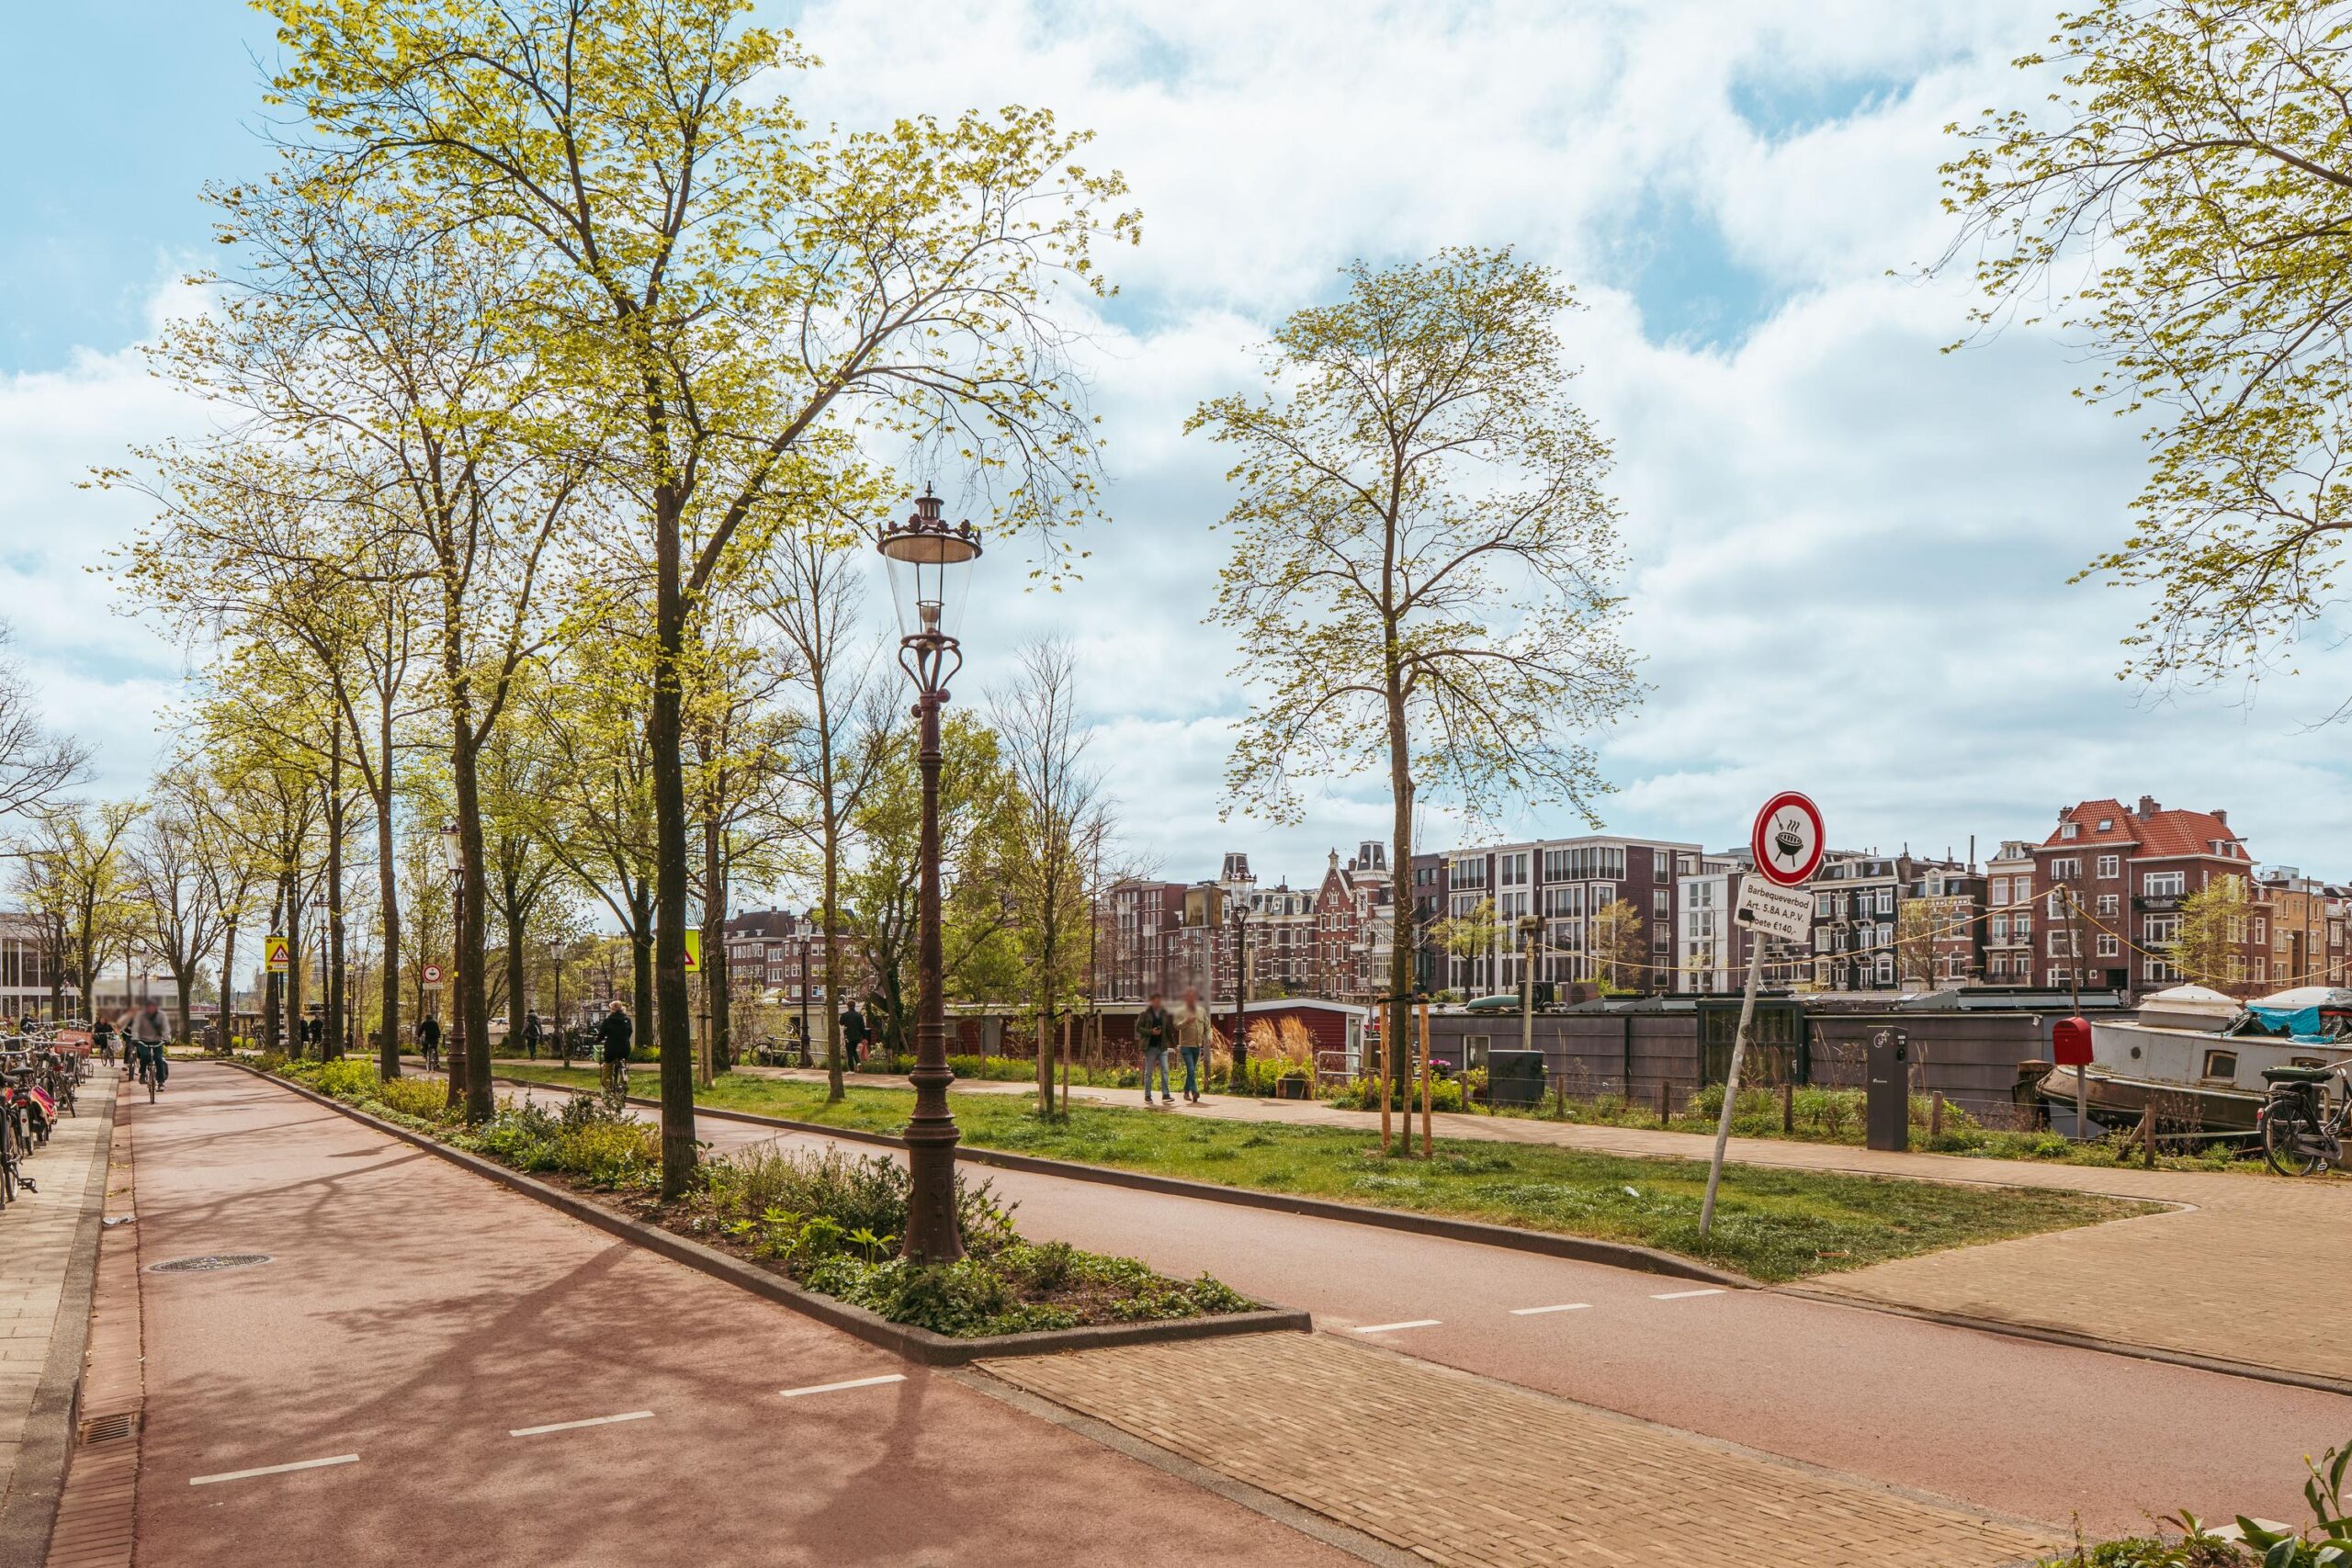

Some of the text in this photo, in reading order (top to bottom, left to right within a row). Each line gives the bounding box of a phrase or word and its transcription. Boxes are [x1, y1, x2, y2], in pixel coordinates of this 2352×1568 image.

[1747, 885, 1809, 908] Barbequeverbod
[1746, 899, 1804, 922] Art. 5.8A A.P.V.
[1773, 921, 1796, 935] €140,-
